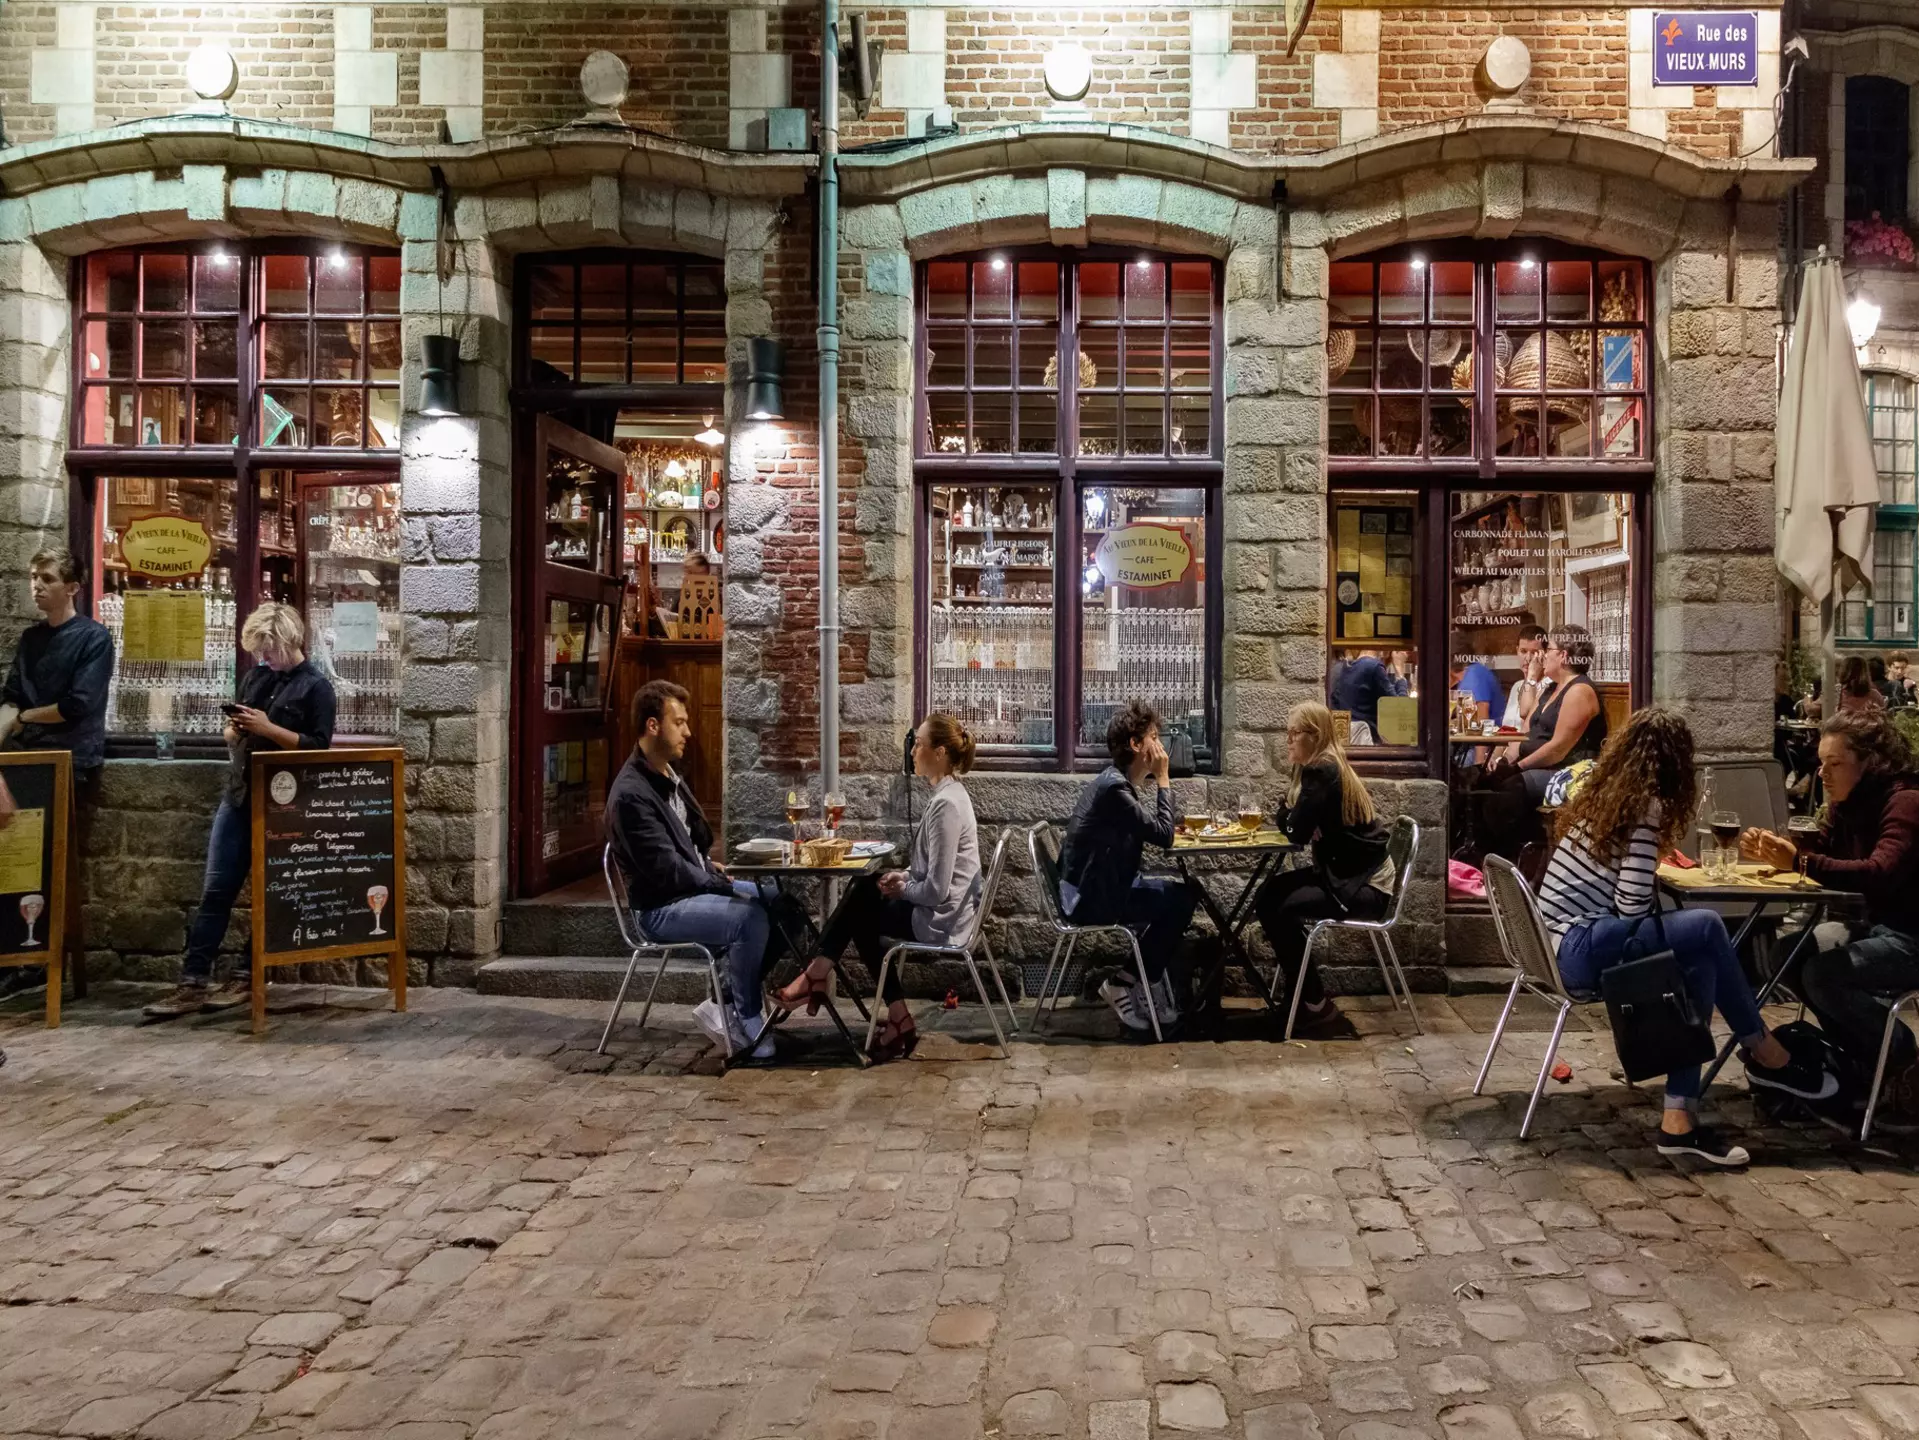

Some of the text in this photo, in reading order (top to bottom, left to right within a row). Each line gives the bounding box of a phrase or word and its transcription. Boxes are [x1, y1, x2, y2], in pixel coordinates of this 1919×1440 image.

[1697, 24, 1748, 41] Rue des
[1666, 53, 1746, 70] VIEUX MURS
[136, 529, 160, 540] VIEUX
[160, 528, 170, 537] DE
[171, 529, 180, 537] LA
[181, 529, 208, 547] VIEILLE
[1453, 530, 1513, 538] CARBONNADE
[1514, 530, 1561, 538] FLAMAN
[156, 547, 176, 555] CAFE
[1114, 538, 1137, 550] VIEUX
[1138, 538, 1148, 546] DE
[1149, 538, 1158, 547] LA
[1160, 537, 1187, 555] VIEILLE
[1017, 553, 1045, 561] MAISON
[1498, 549, 1530, 557] POULET
[1532, 549, 1545, 557] AU
[139, 559, 193, 572] ESTAMINET
[1135, 556, 1155, 564] CAFE
[1117, 569, 1172, 582] ESTAMINET
[1454, 567, 1483, 575] WELCH
[1486, 567, 1497, 575] AU
[1499, 567, 1545, 575] MAROILLES
[1455, 614, 1521, 625] CRÊPE MAISON
